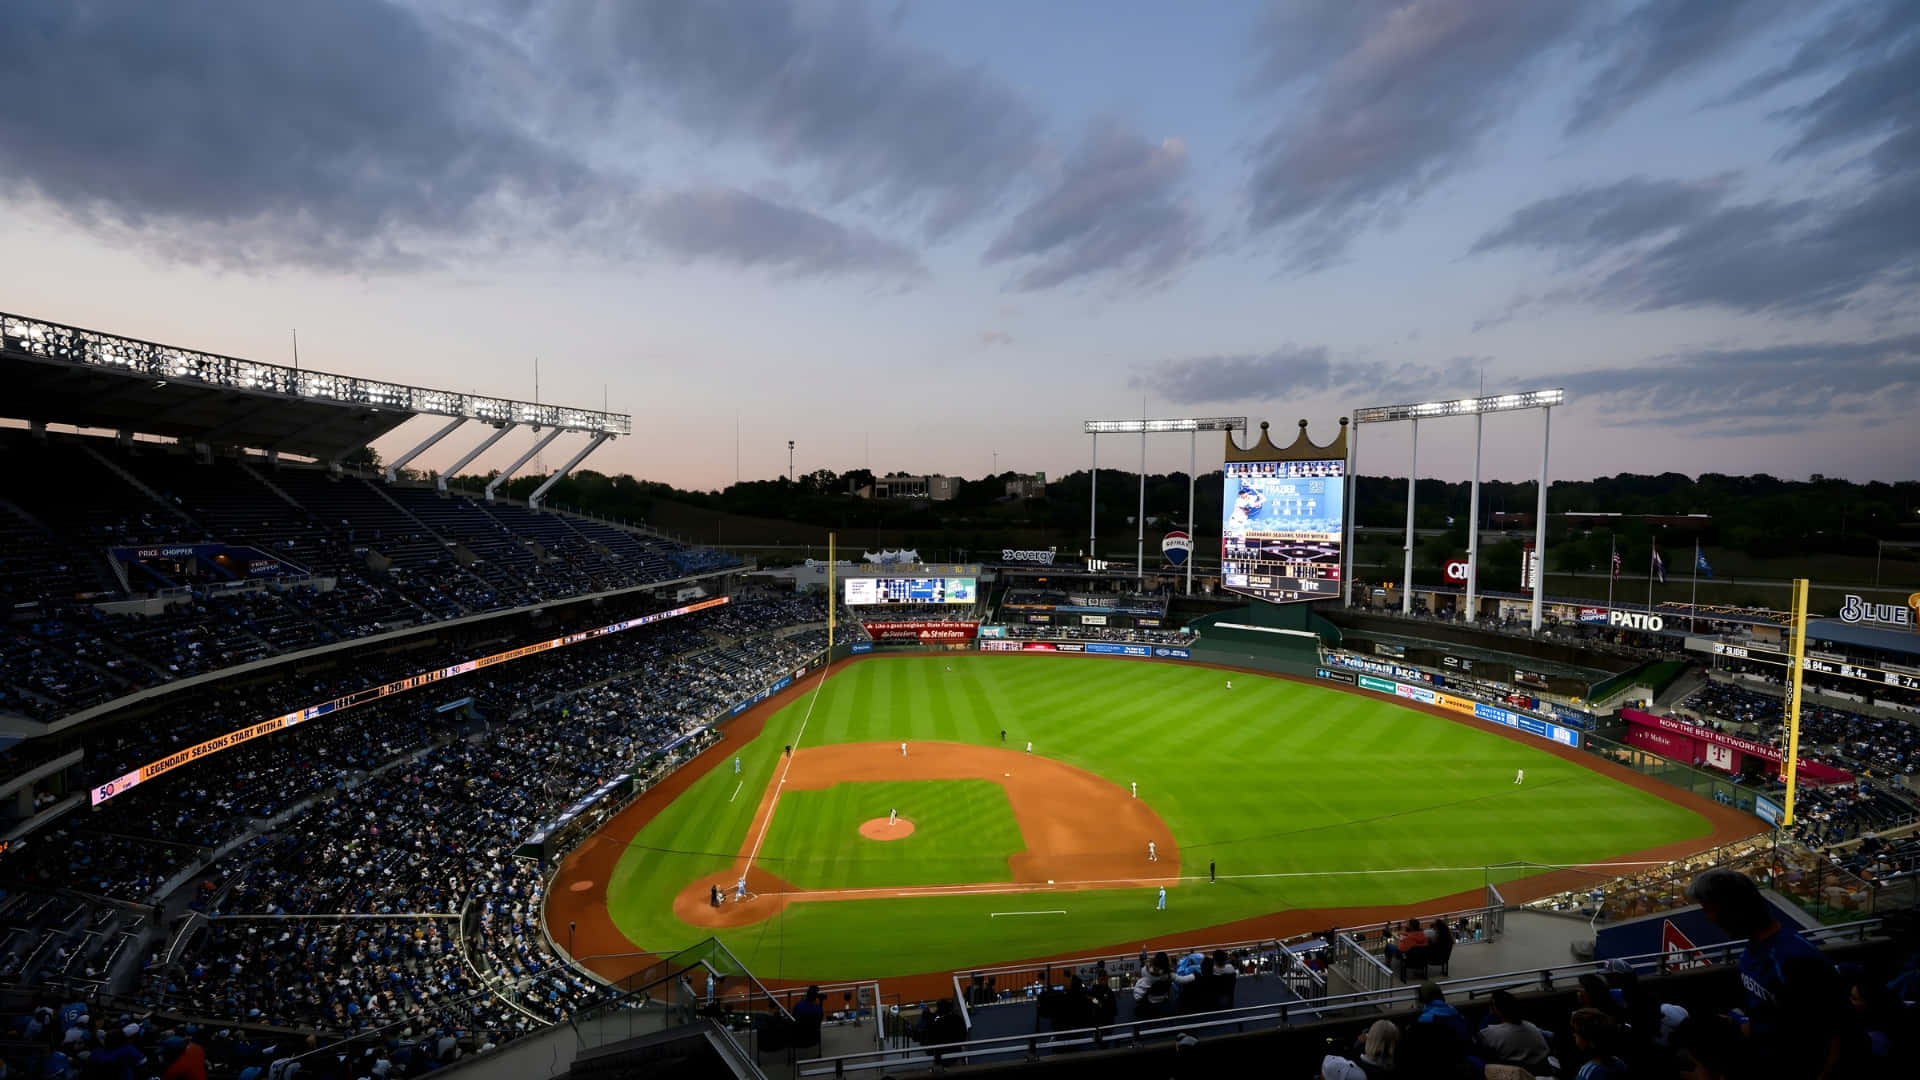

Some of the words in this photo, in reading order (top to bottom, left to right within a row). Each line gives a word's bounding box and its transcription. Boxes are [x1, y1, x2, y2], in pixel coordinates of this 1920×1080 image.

[162, 548, 192, 556] CHOPPER
[1015, 550, 1056, 564] evergy
[1088, 559, 1108, 572] Lite
[1840, 594, 1908, 624] BLUE
[1610, 611, 1663, 631] PATIO
[1726, 646, 1748, 657] SLIDER
[1344, 658, 1392, 674] FOUNTAIN
[1396, 668, 1422, 680] DECK
[1812, 661, 1822, 670] 84
[1856, 669, 1862, 678] 4
[1903, 678, 1912, 686] -7
[1476, 710, 1505, 722] AIRLINES
[1480, 707, 1505, 716] UNITED
[146, 751, 190, 777] LEGENDARY
[191, 737, 228, 758] SEASONS
[230, 728, 254, 744] START
[256, 721, 275, 734] WITH
[276, 719, 282, 727] A
[1660, 719, 1678, 729] NOW
[1680, 725, 1694, 734] THE
[1695, 728, 1714, 738] BEST
[1716, 734, 1755, 752] NETWORK
[1768, 751, 1807, 767] AMCA
[100, 783, 114, 800] 50
